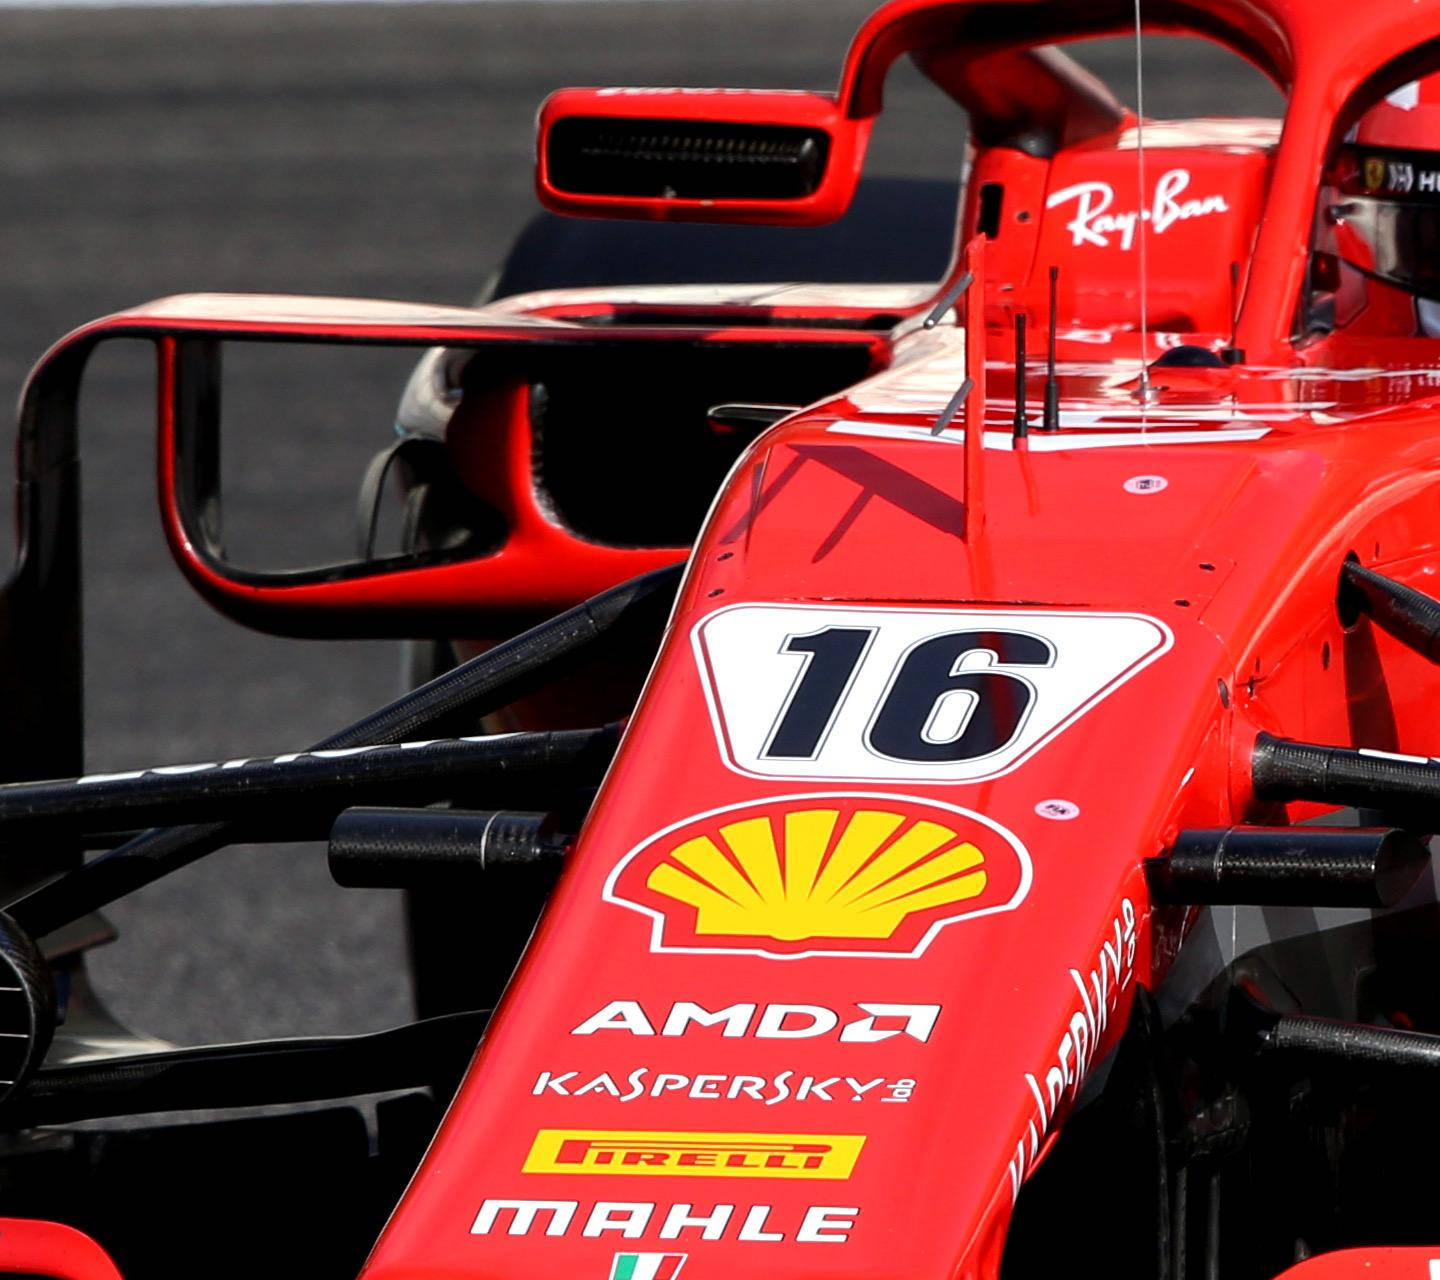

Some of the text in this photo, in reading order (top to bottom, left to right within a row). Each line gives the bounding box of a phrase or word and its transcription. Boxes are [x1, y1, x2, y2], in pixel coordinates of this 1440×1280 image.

[1046, 169, 1229, 251] Ray-Ban
[757, 624, 1058, 763] 16
[570, 1000, 840, 1038] AMD
[532, 1067, 885, 1105] KASPERSKY
[554, 1139, 833, 1169] PIRELLI
[469, 1199, 860, 1242] MAHLE
